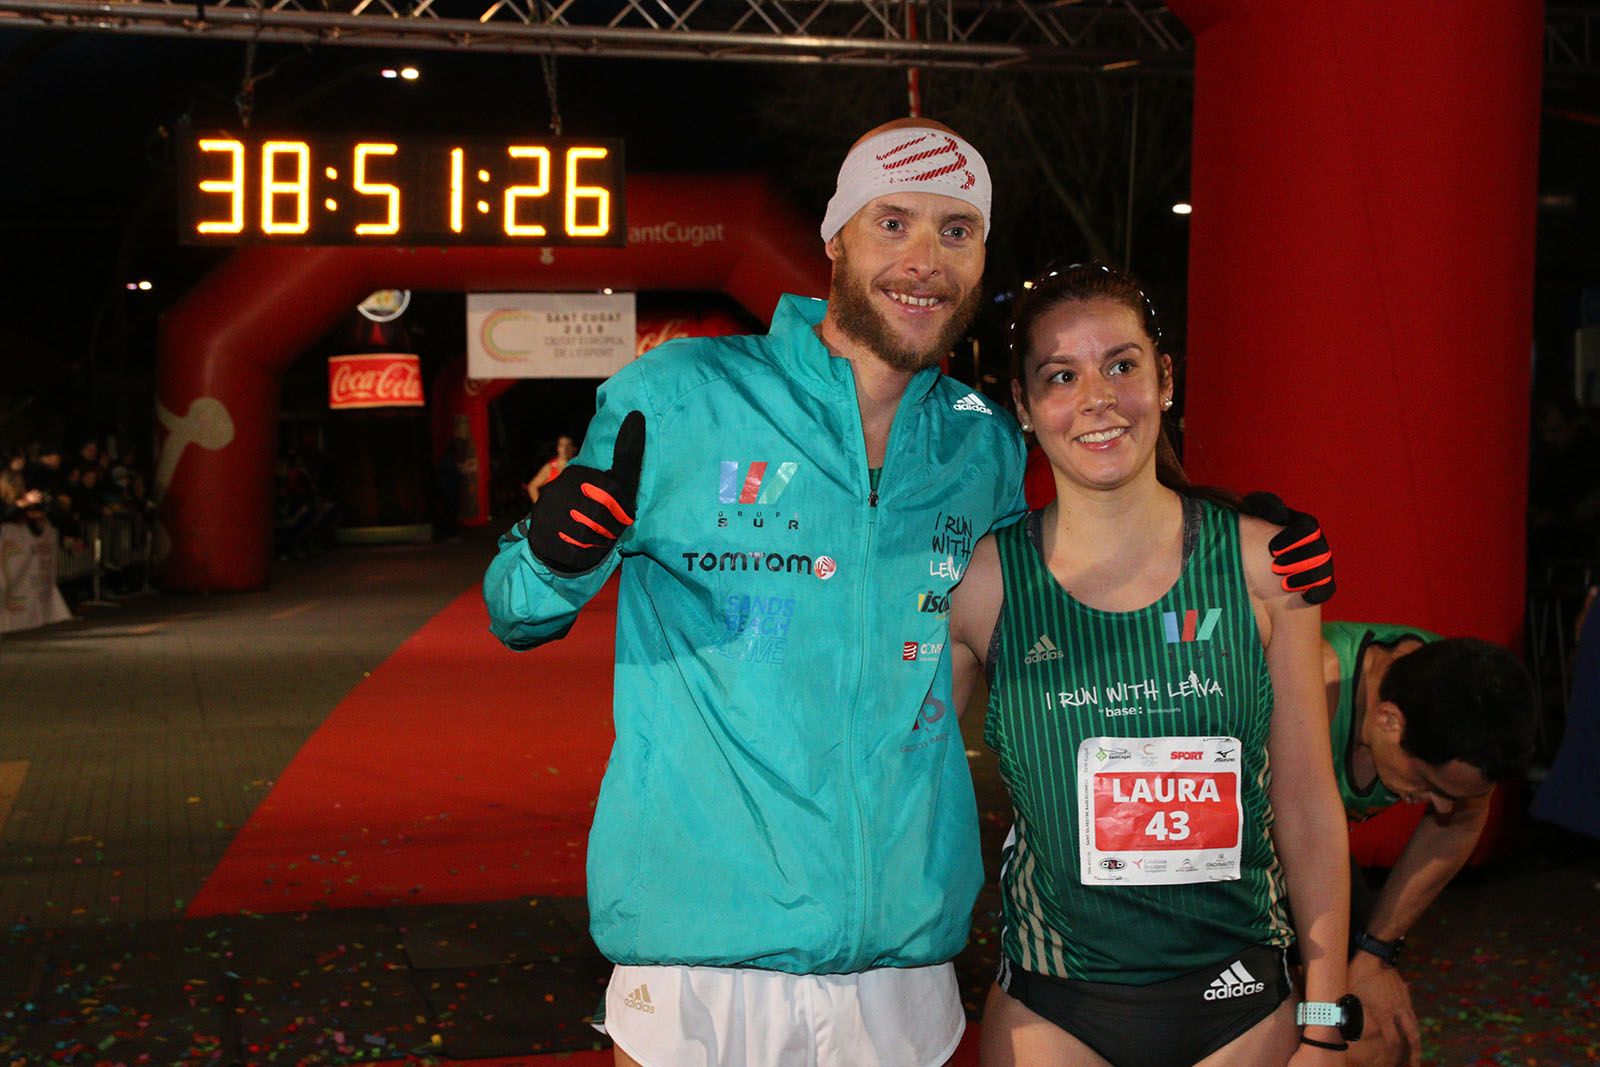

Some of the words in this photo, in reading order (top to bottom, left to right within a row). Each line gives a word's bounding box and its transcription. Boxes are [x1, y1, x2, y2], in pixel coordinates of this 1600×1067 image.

[628, 221, 724, 247] antCugat
[953, 402, 993, 416] adidas
[717, 518, 799, 530] SUR
[934, 511, 942, 531] I
[945, 515, 972, 539] RUN
[932, 533, 972, 561] WITH
[1024, 649, 1064, 665] adidas
[1046, 692, 1052, 710] I
[1059, 686, 1098, 708] RUN
[1106, 679, 1159, 702] WITH
[1167, 671, 1224, 698] LEIVA
[1170, 751, 1204, 760] SPORT
[1111, 777, 1222, 803] LAURA
[1144, 810, 1191, 841] 43
[1203, 981, 1265, 1001] adidas
[623, 998, 656, 1014] adidas
